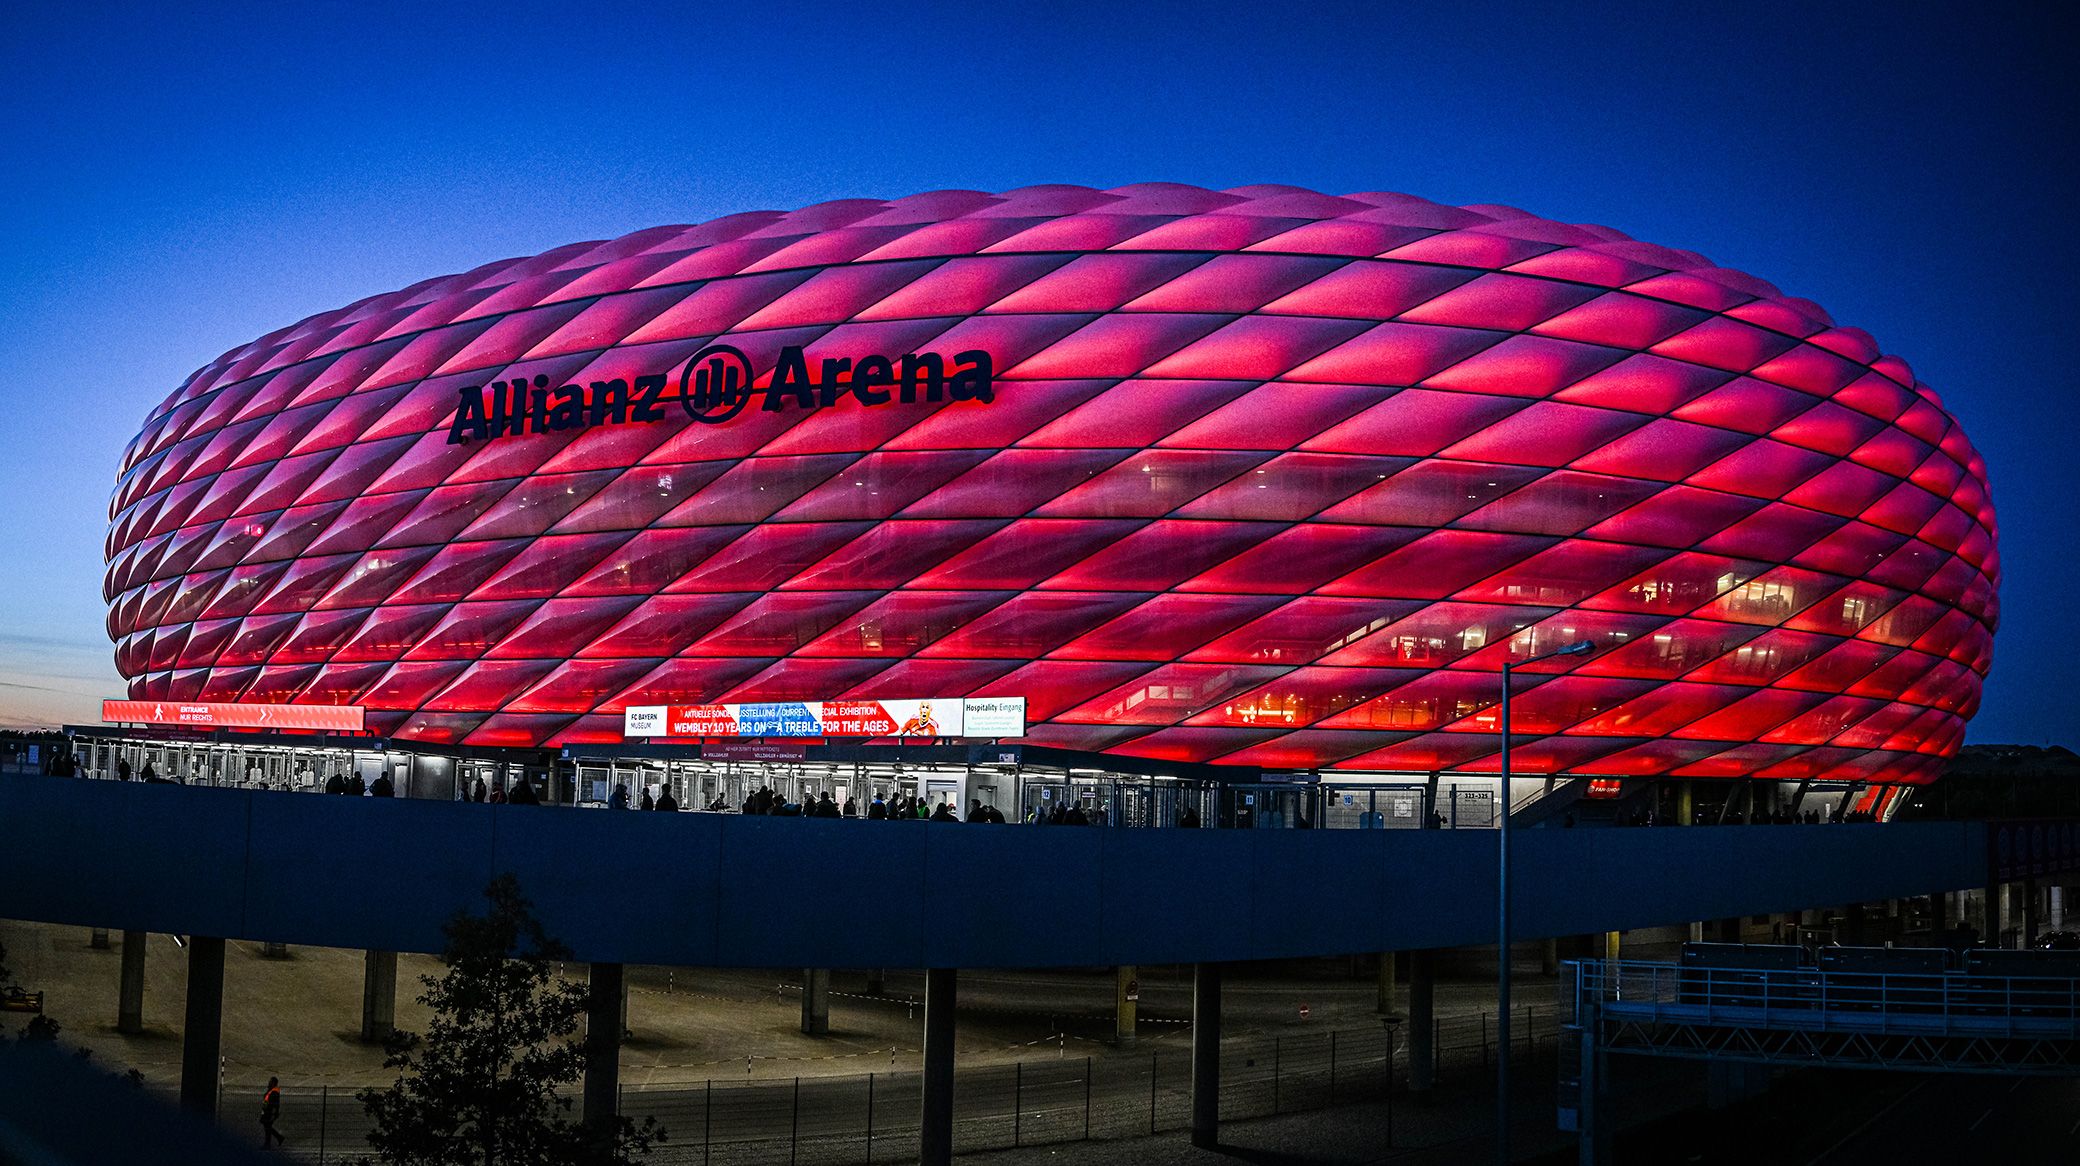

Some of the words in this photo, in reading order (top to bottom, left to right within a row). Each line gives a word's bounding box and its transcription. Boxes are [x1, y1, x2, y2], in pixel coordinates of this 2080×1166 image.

[447, 372, 668, 445] Allianz
[762, 344, 996, 412] Arena
[180, 706, 209, 714] ENTRANCE
[684, 709, 712, 719] AKTUELLE
[840, 706, 877, 716] EXHIBITION
[966, 703, 998, 713] Hospitality
[999, 703, 1022, 713] Eingang
[180, 713, 192, 721] NUR
[192, 714, 213, 722] RECHTS
[631, 713, 638, 721] FC
[638, 713, 658, 721] BAYERN
[631, 721, 652, 730] MUSEUM
[674, 722, 712, 734] WEMBLEY
[713, 722, 725, 734] 10
[725, 721, 752, 733] YEARS
[753, 721, 767, 733] ON
[776, 721, 783, 733] A
[784, 721, 819, 733] TREBLE
[821, 721, 841, 733] FOR
[842, 720, 861, 732] THE
[862, 720, 889, 732] AGES
